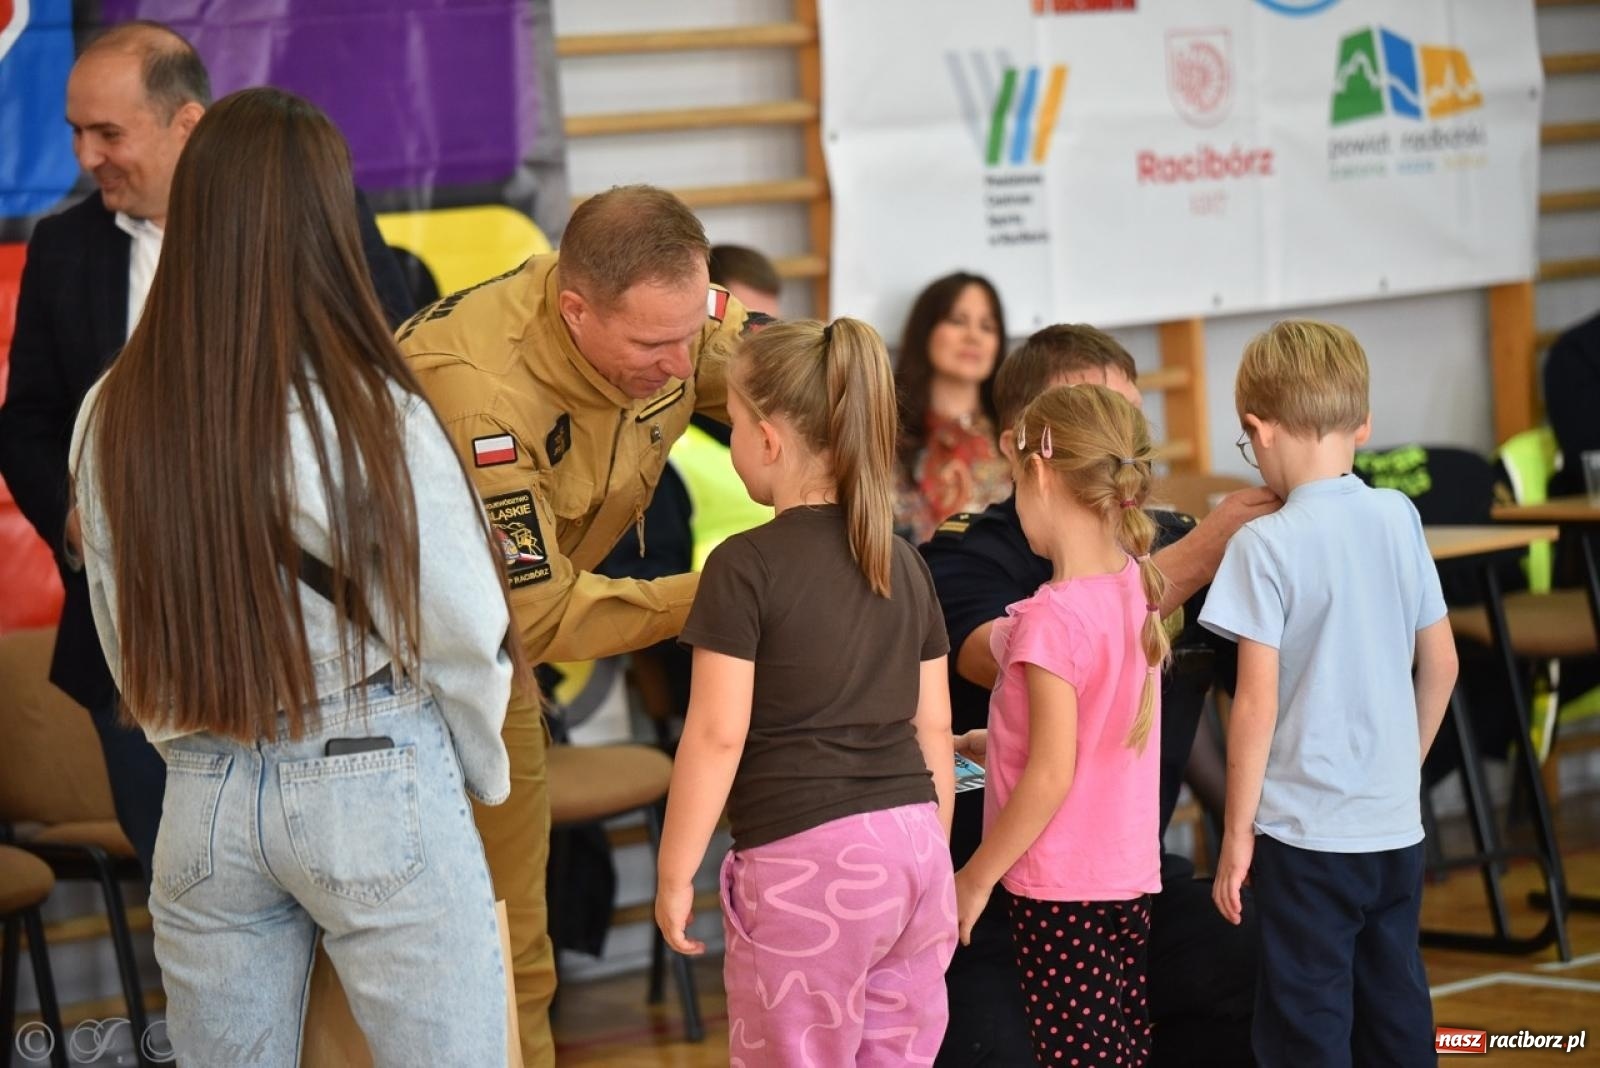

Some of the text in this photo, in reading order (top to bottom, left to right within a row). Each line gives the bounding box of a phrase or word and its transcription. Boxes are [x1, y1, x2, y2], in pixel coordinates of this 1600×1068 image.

[1136, 142, 1275, 184] Racibórz
[486, 495, 529, 509] OJEWÓDZTWO
[488, 504, 531, 520] LĄSKIE
